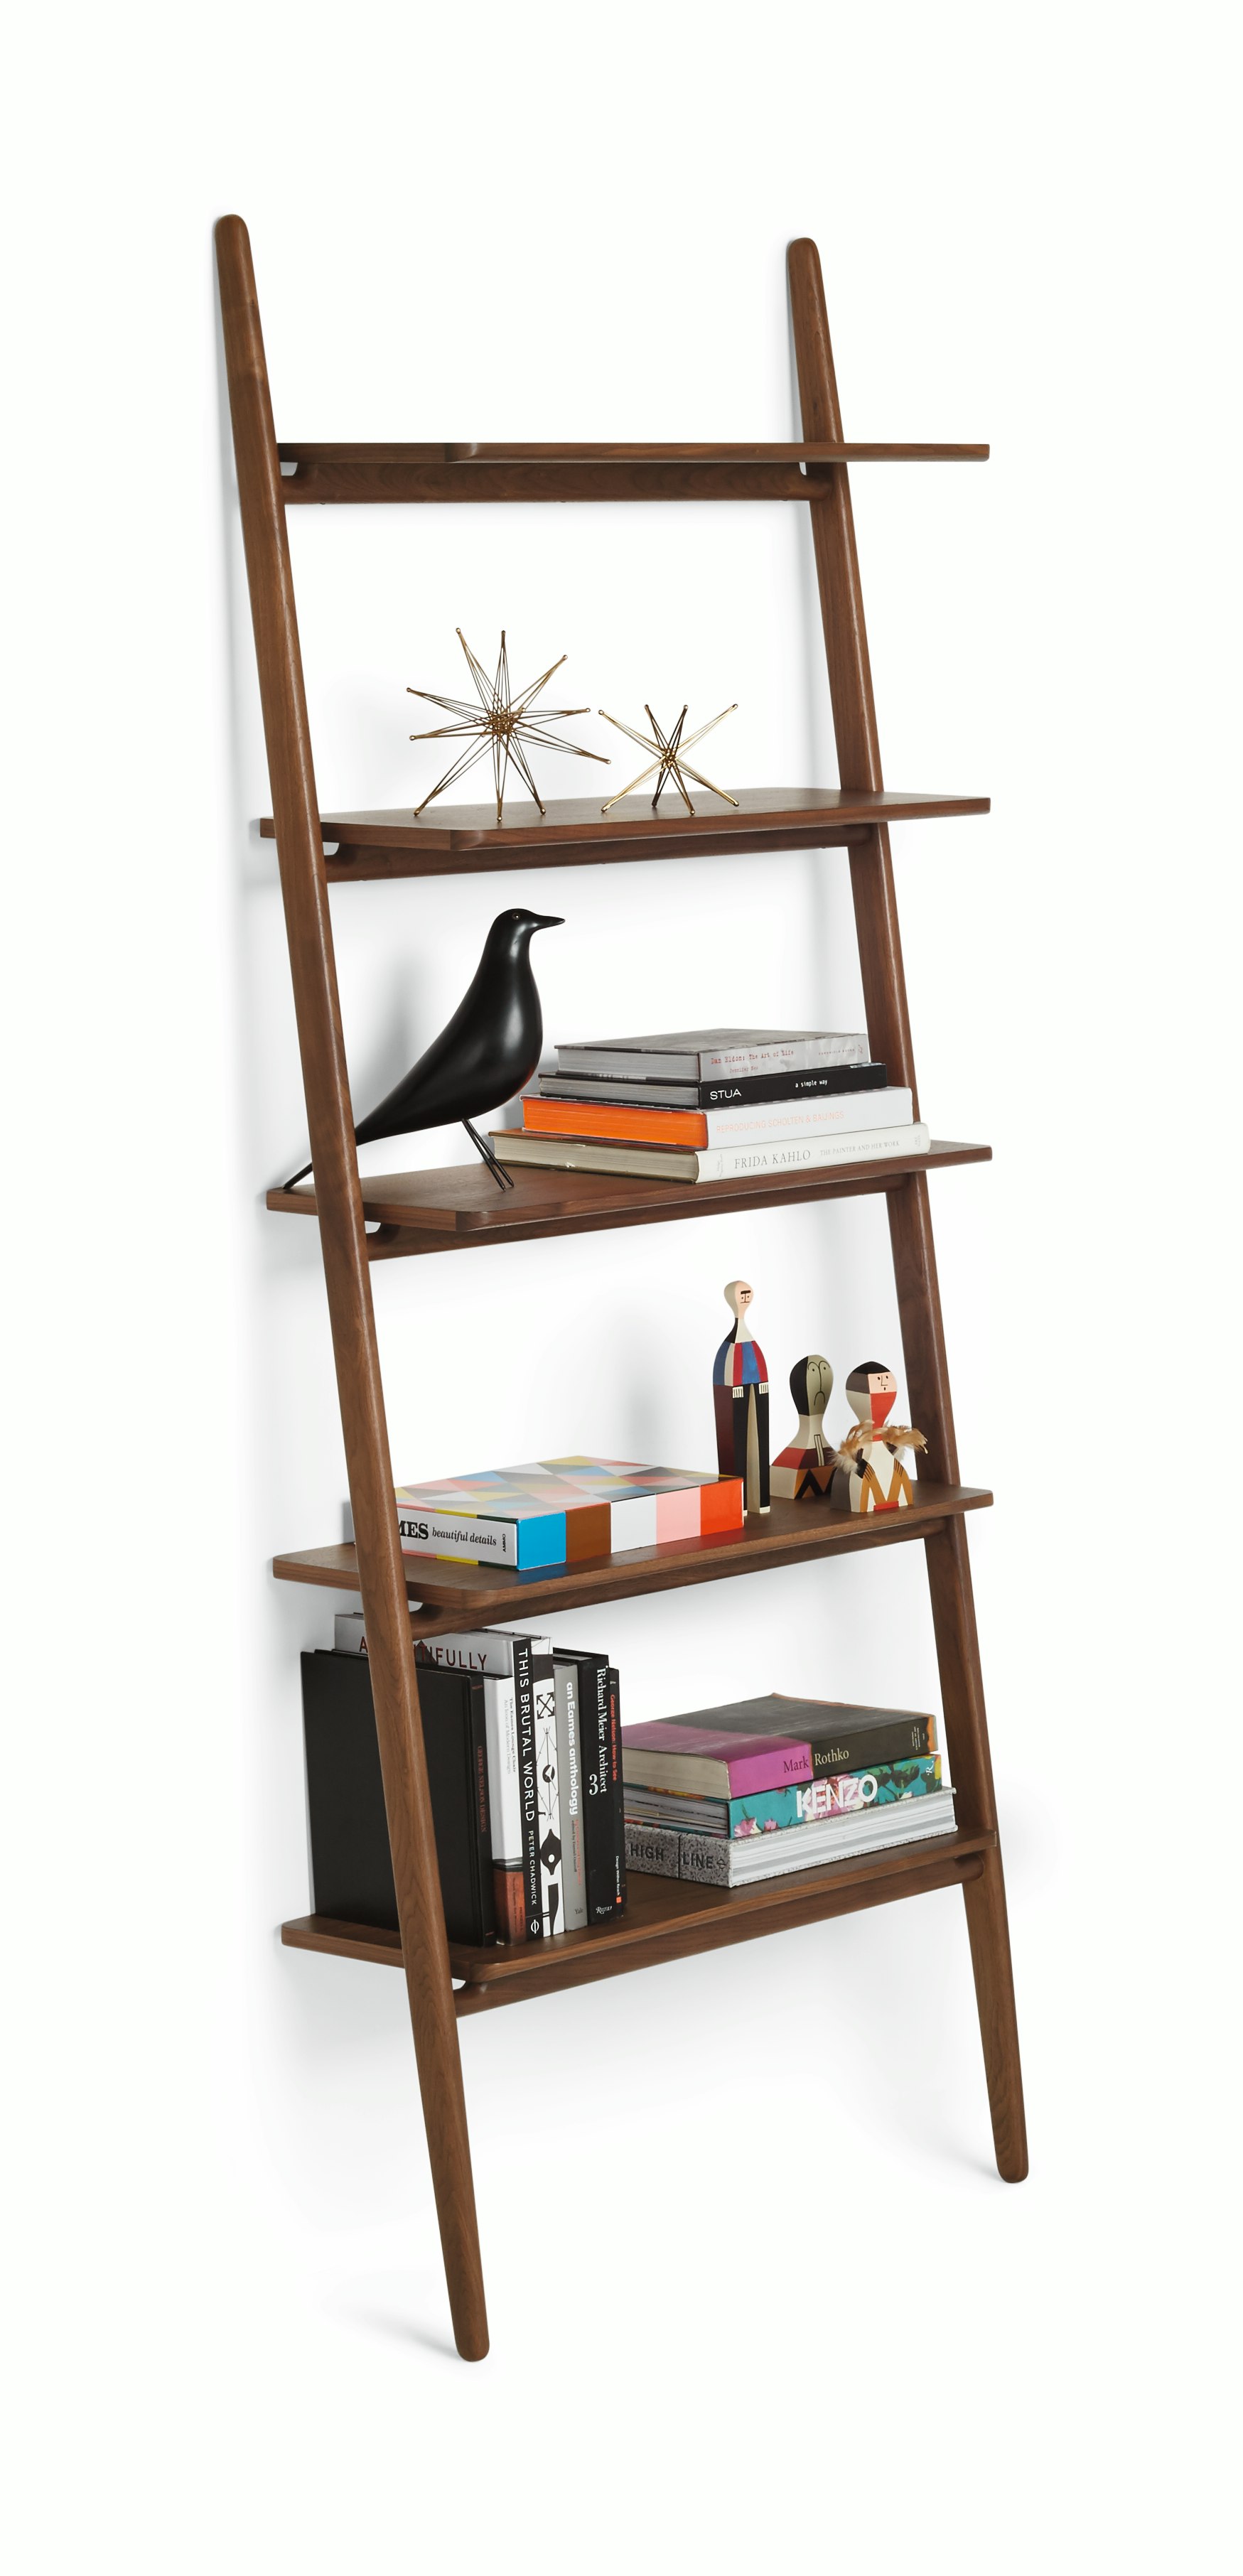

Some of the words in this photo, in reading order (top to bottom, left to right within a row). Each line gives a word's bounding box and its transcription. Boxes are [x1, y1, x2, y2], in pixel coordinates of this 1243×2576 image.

[709, 1088, 742, 1101] STUA
[801, 1079, 817, 1089] simple
[716, 1120, 767, 1133] REPRODUCING
[768, 1116, 805, 1128] SCHOLTEN
[734, 1155, 768, 1169] FRIDA
[772, 1149, 812, 1164] KAHLO
[832, 1146, 856, 1155] PAINTER
[858, 1143, 870, 1152] AND
[399, 1520, 429, 1540] MES
[431, 1526, 468, 1543] beautiful
[470, 1533, 497, 1546] details
[518, 1648, 529, 1688] THIS
[566, 1682, 574, 1699] an
[597, 1669, 607, 1710] Richard
[520, 1693, 532, 1757] BRUTAL
[566, 1701, 576, 1746] Eames
[598, 1712, 608, 1741] Meier
[599, 1745, 609, 1793] Architect
[783, 1756, 809, 1773] Mark
[814, 1747, 849, 1766] Rothko
[523, 1761, 535, 1822] WORLD
[569, 1748, 579, 1816] anthology
[588, 1774, 598, 1795] 3
[795, 1774, 878, 1818] KENZO
[630, 1843, 664, 1861] HIGH
[682, 1852, 714, 1870] LINE
